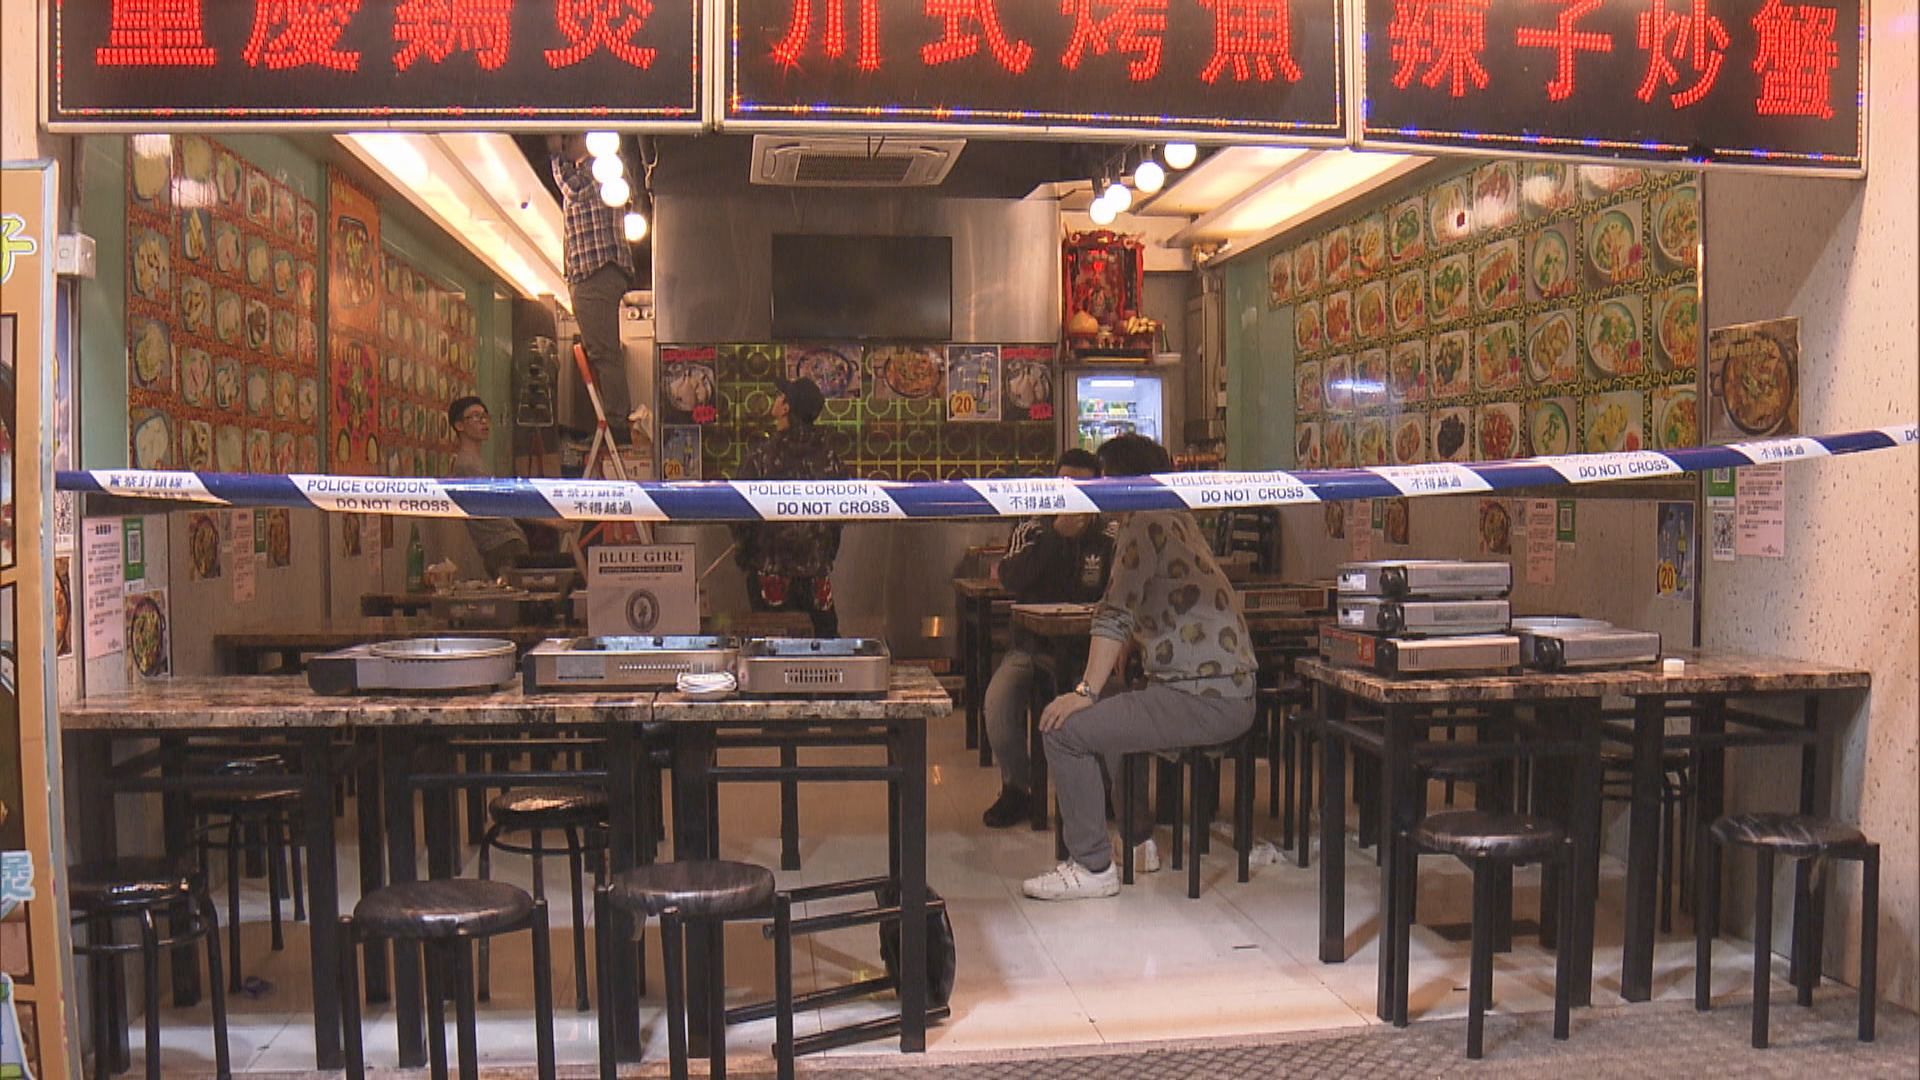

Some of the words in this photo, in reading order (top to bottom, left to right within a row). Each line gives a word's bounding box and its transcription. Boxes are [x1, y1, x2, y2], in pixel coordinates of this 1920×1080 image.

[1388, 0, 1839, 119] 辣子炒蟹
[955, 395, 972, 413] 20
[667, 463, 681, 475] 20
[1578, 466, 1597, 478] DO
[1600, 464, 1624, 477] NOT
[1628, 460, 1670, 473] CROSS
[307, 479, 361, 492] POLICE
[749, 484, 801, 495] POLICE
[1009, 495, 1066, 510] 不得越過
[1201, 489, 1221, 504] DO
[1224, 489, 1250, 502] NOT
[1258, 487, 1304, 500] CROSS
[336, 498, 358, 510] DO
[361, 499, 392, 511] NOT
[399, 500, 450, 512] CROSS
[574, 500, 632, 515] 不得越過
[777, 502, 799, 515] DO
[802, 502, 832, 515] NOT
[839, 500, 890, 514] CROSS
[599, 551, 640, 563] BLUE
[643, 551, 683, 563] GIRL
[1661, 566, 1674, 589] 20
